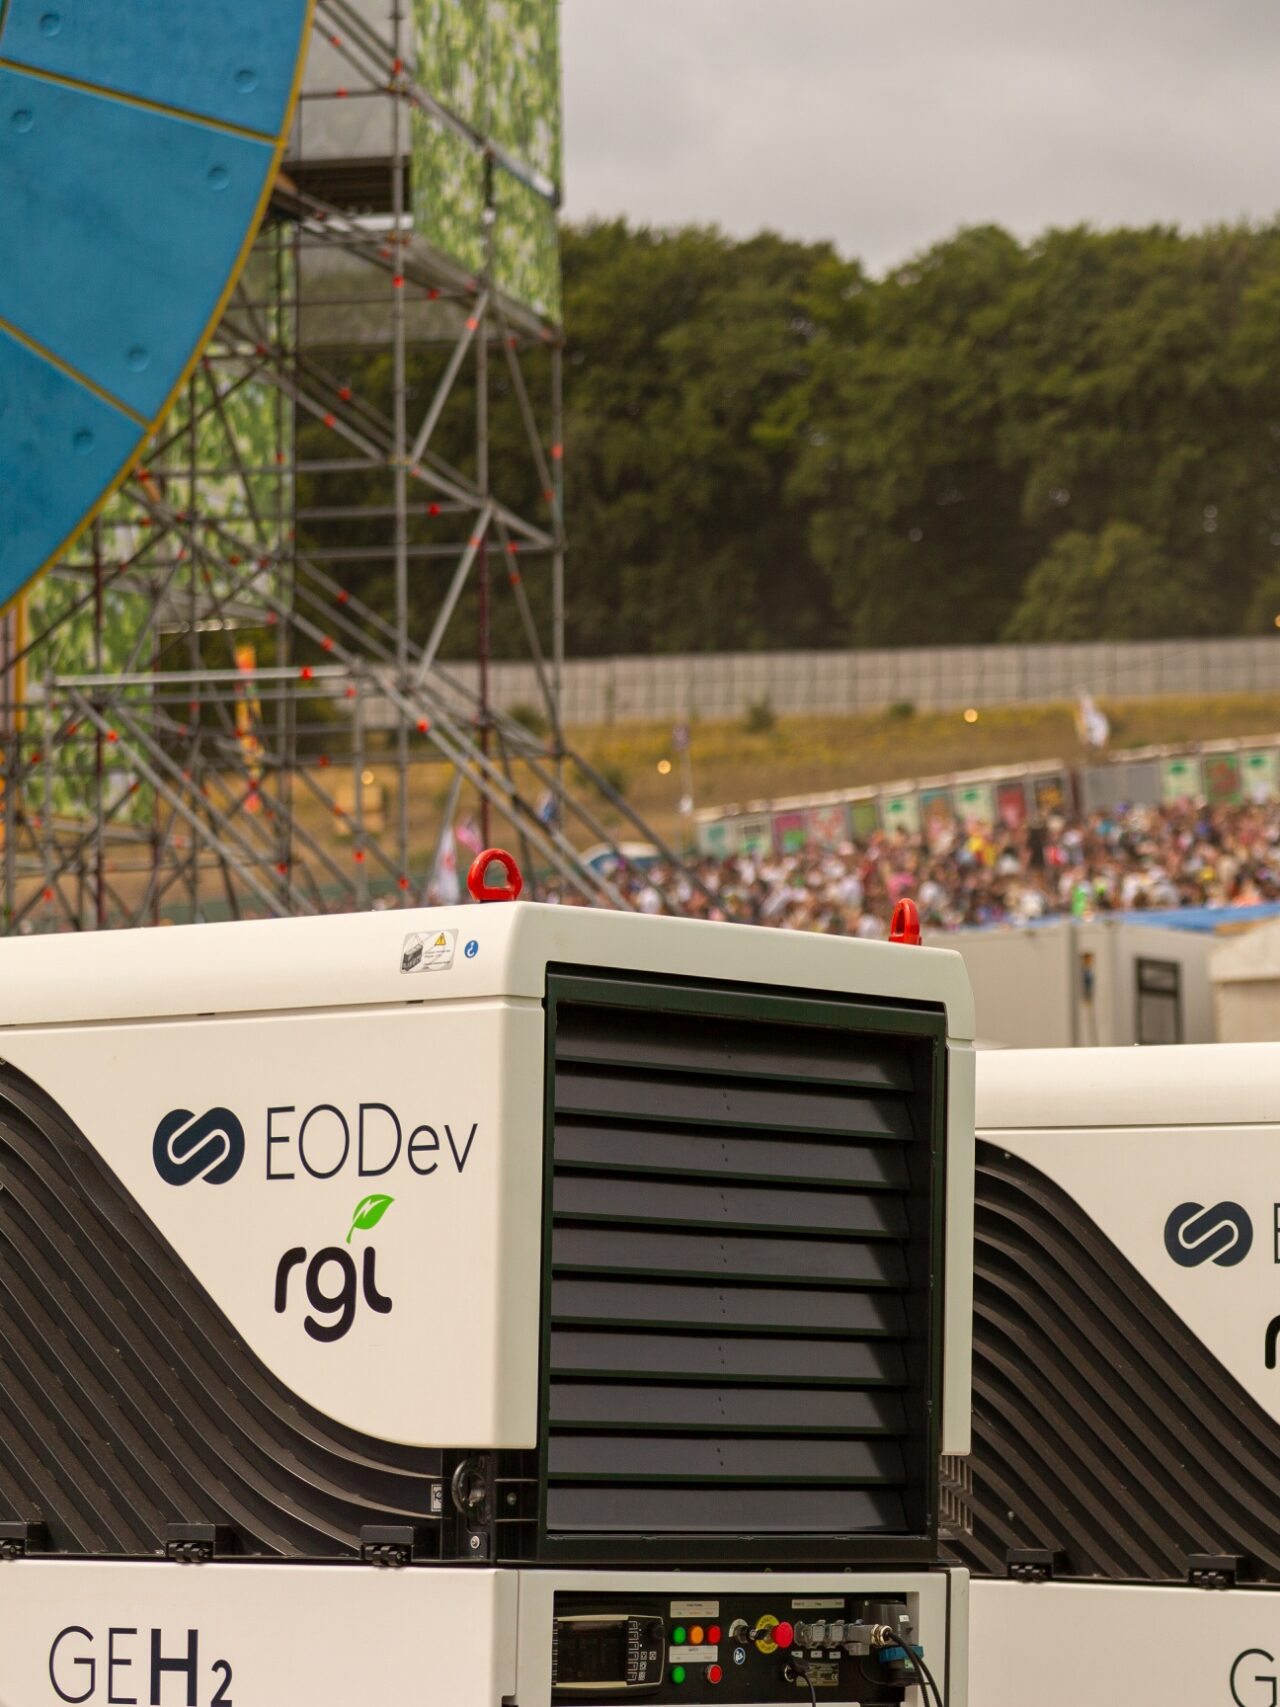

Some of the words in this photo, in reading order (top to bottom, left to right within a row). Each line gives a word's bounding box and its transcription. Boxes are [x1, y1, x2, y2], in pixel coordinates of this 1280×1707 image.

[267, 1102, 478, 1181] EODev
[274, 1246, 393, 1343] rgl
[48, 1625, 233, 1707] GEH2
